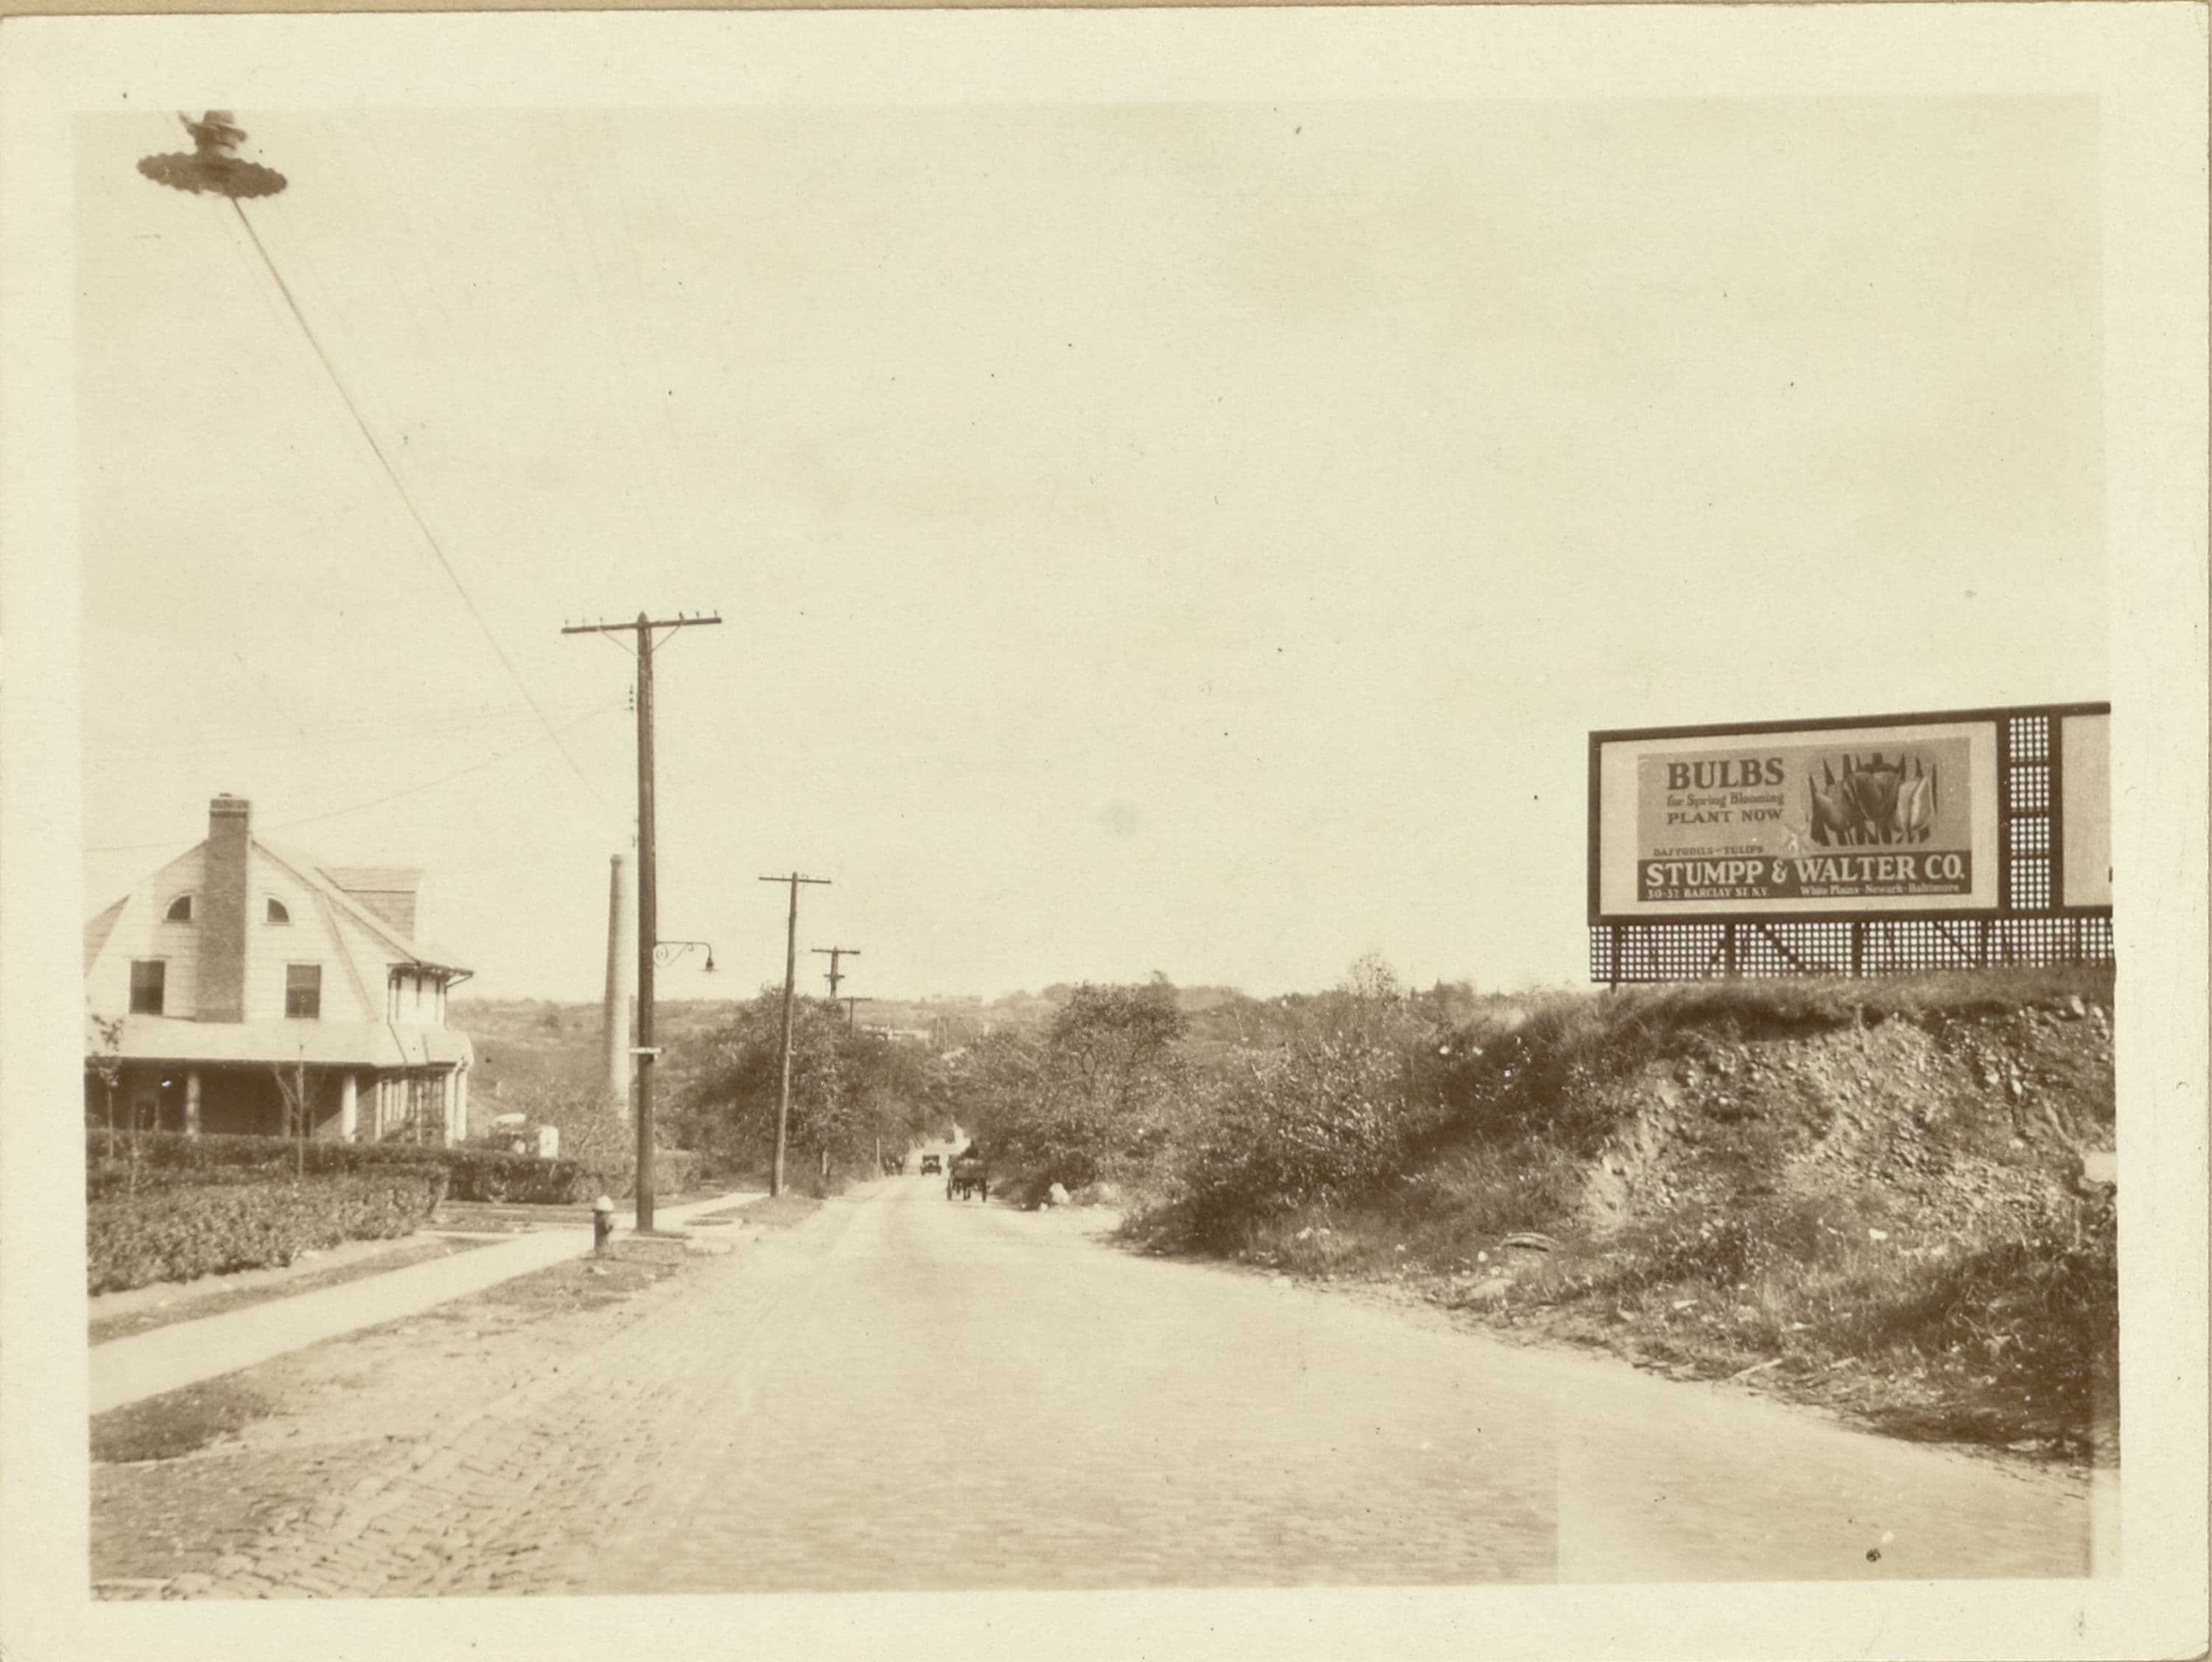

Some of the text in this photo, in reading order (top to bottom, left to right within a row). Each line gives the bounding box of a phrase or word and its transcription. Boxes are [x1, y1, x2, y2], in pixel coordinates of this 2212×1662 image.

[1667, 757, 1784, 790] BULBS
[1667, 792, 1784, 808] for Spring Blooming
[1667, 808, 1783, 824] PLANT NOW
[1645, 854, 1965, 886] STUMPP & WALTER CO.
[1684, 886, 1732, 897] BARCLAY
[1800, 883, 1959, 896] White Plains Newark Baltimore
